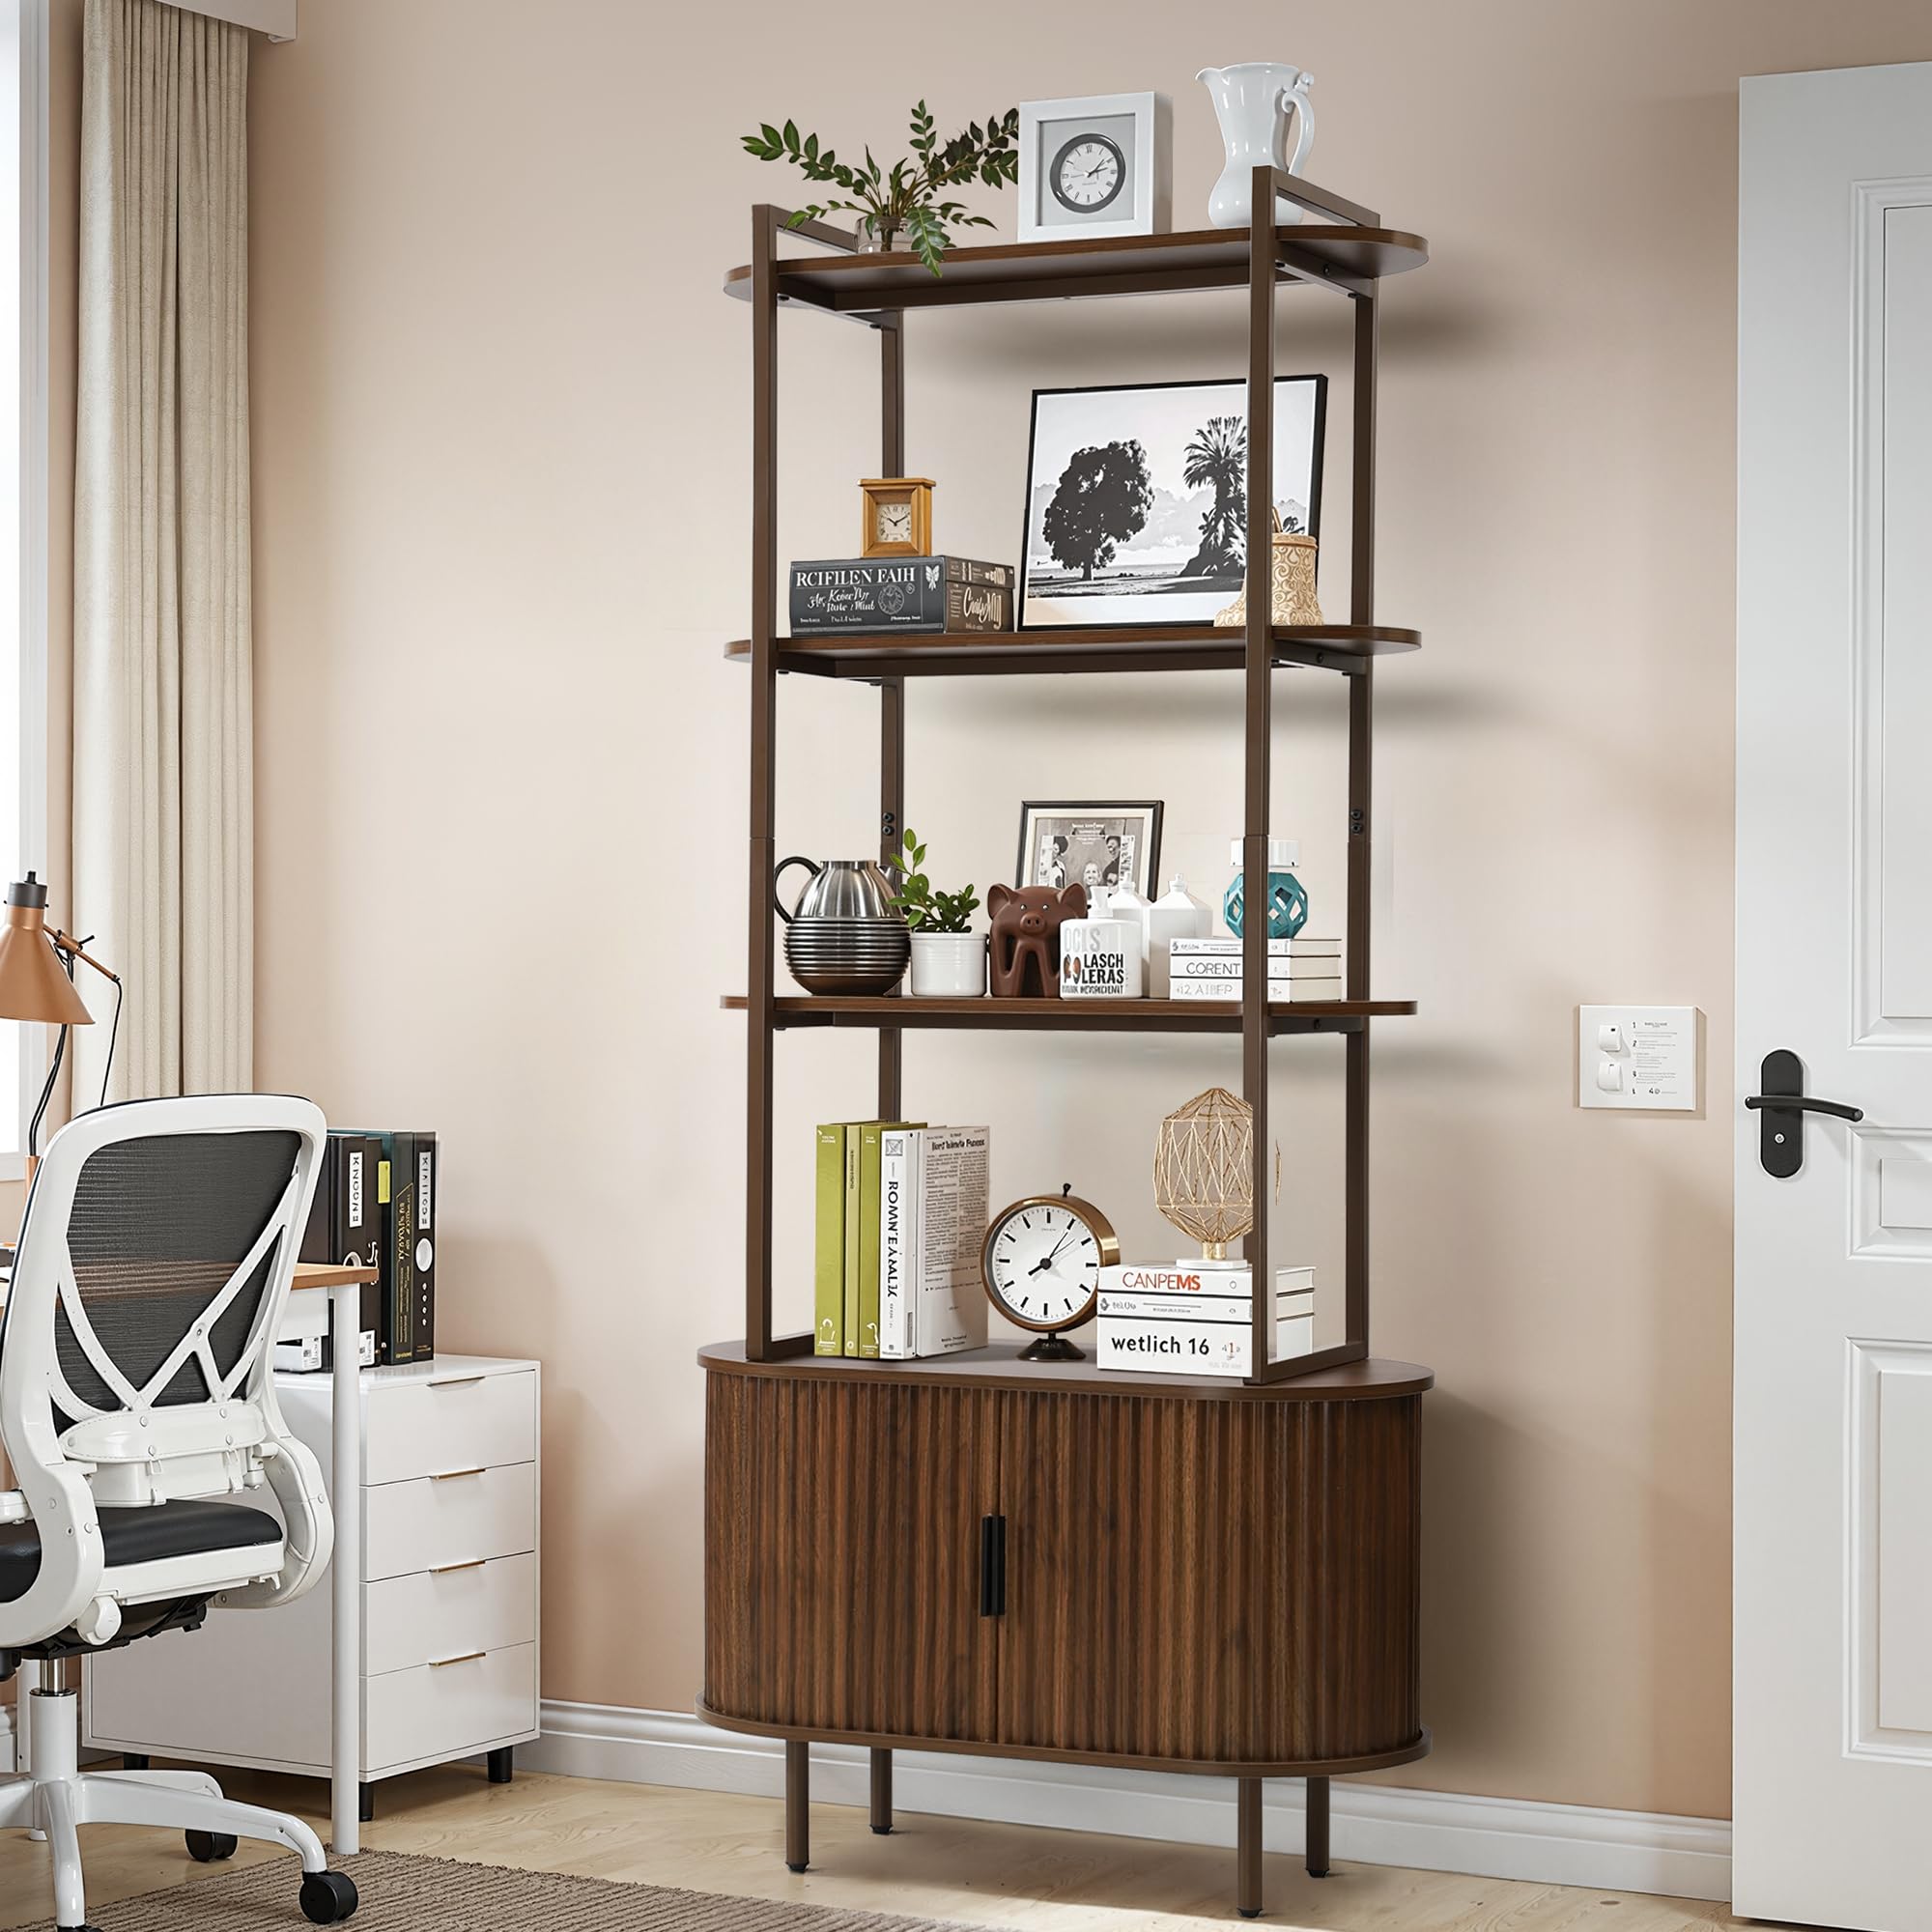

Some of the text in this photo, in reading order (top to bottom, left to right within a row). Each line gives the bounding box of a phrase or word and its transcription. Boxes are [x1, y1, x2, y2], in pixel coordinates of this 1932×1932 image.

[1084, 952, 1123, 969] LASCH
[1185, 961, 1241, 975] CORENT
[1081, 969, 1124, 984] LERAS
[1122, 1272, 1201, 1291] CANPEMS
[1111, 1335, 1210, 1355] wetlich 16
